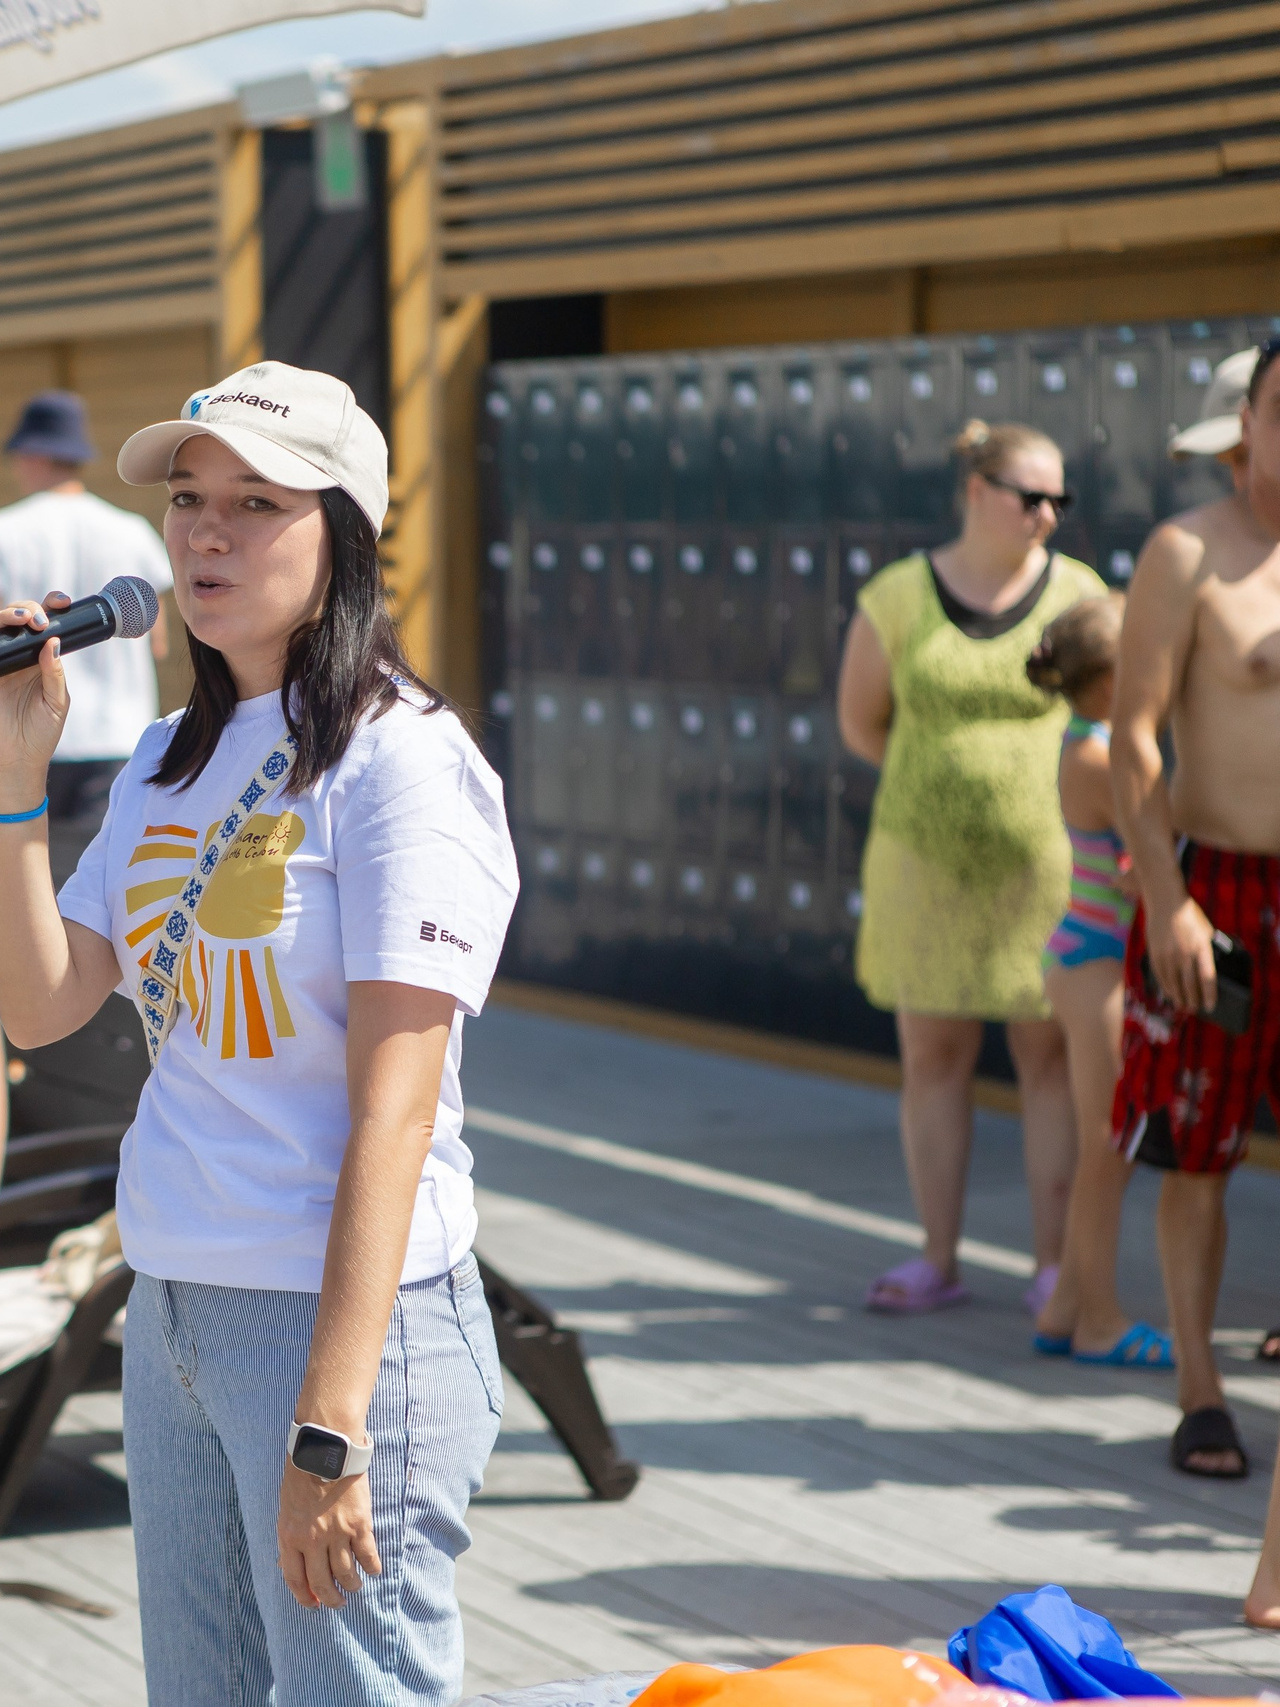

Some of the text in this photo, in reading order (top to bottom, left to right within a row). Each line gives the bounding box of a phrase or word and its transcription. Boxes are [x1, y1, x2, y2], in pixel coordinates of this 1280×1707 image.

[208, 391, 291, 418] Bekaert
[95, 602, 109, 626] SHURE
[440, 929, 473, 954] Бекарт
